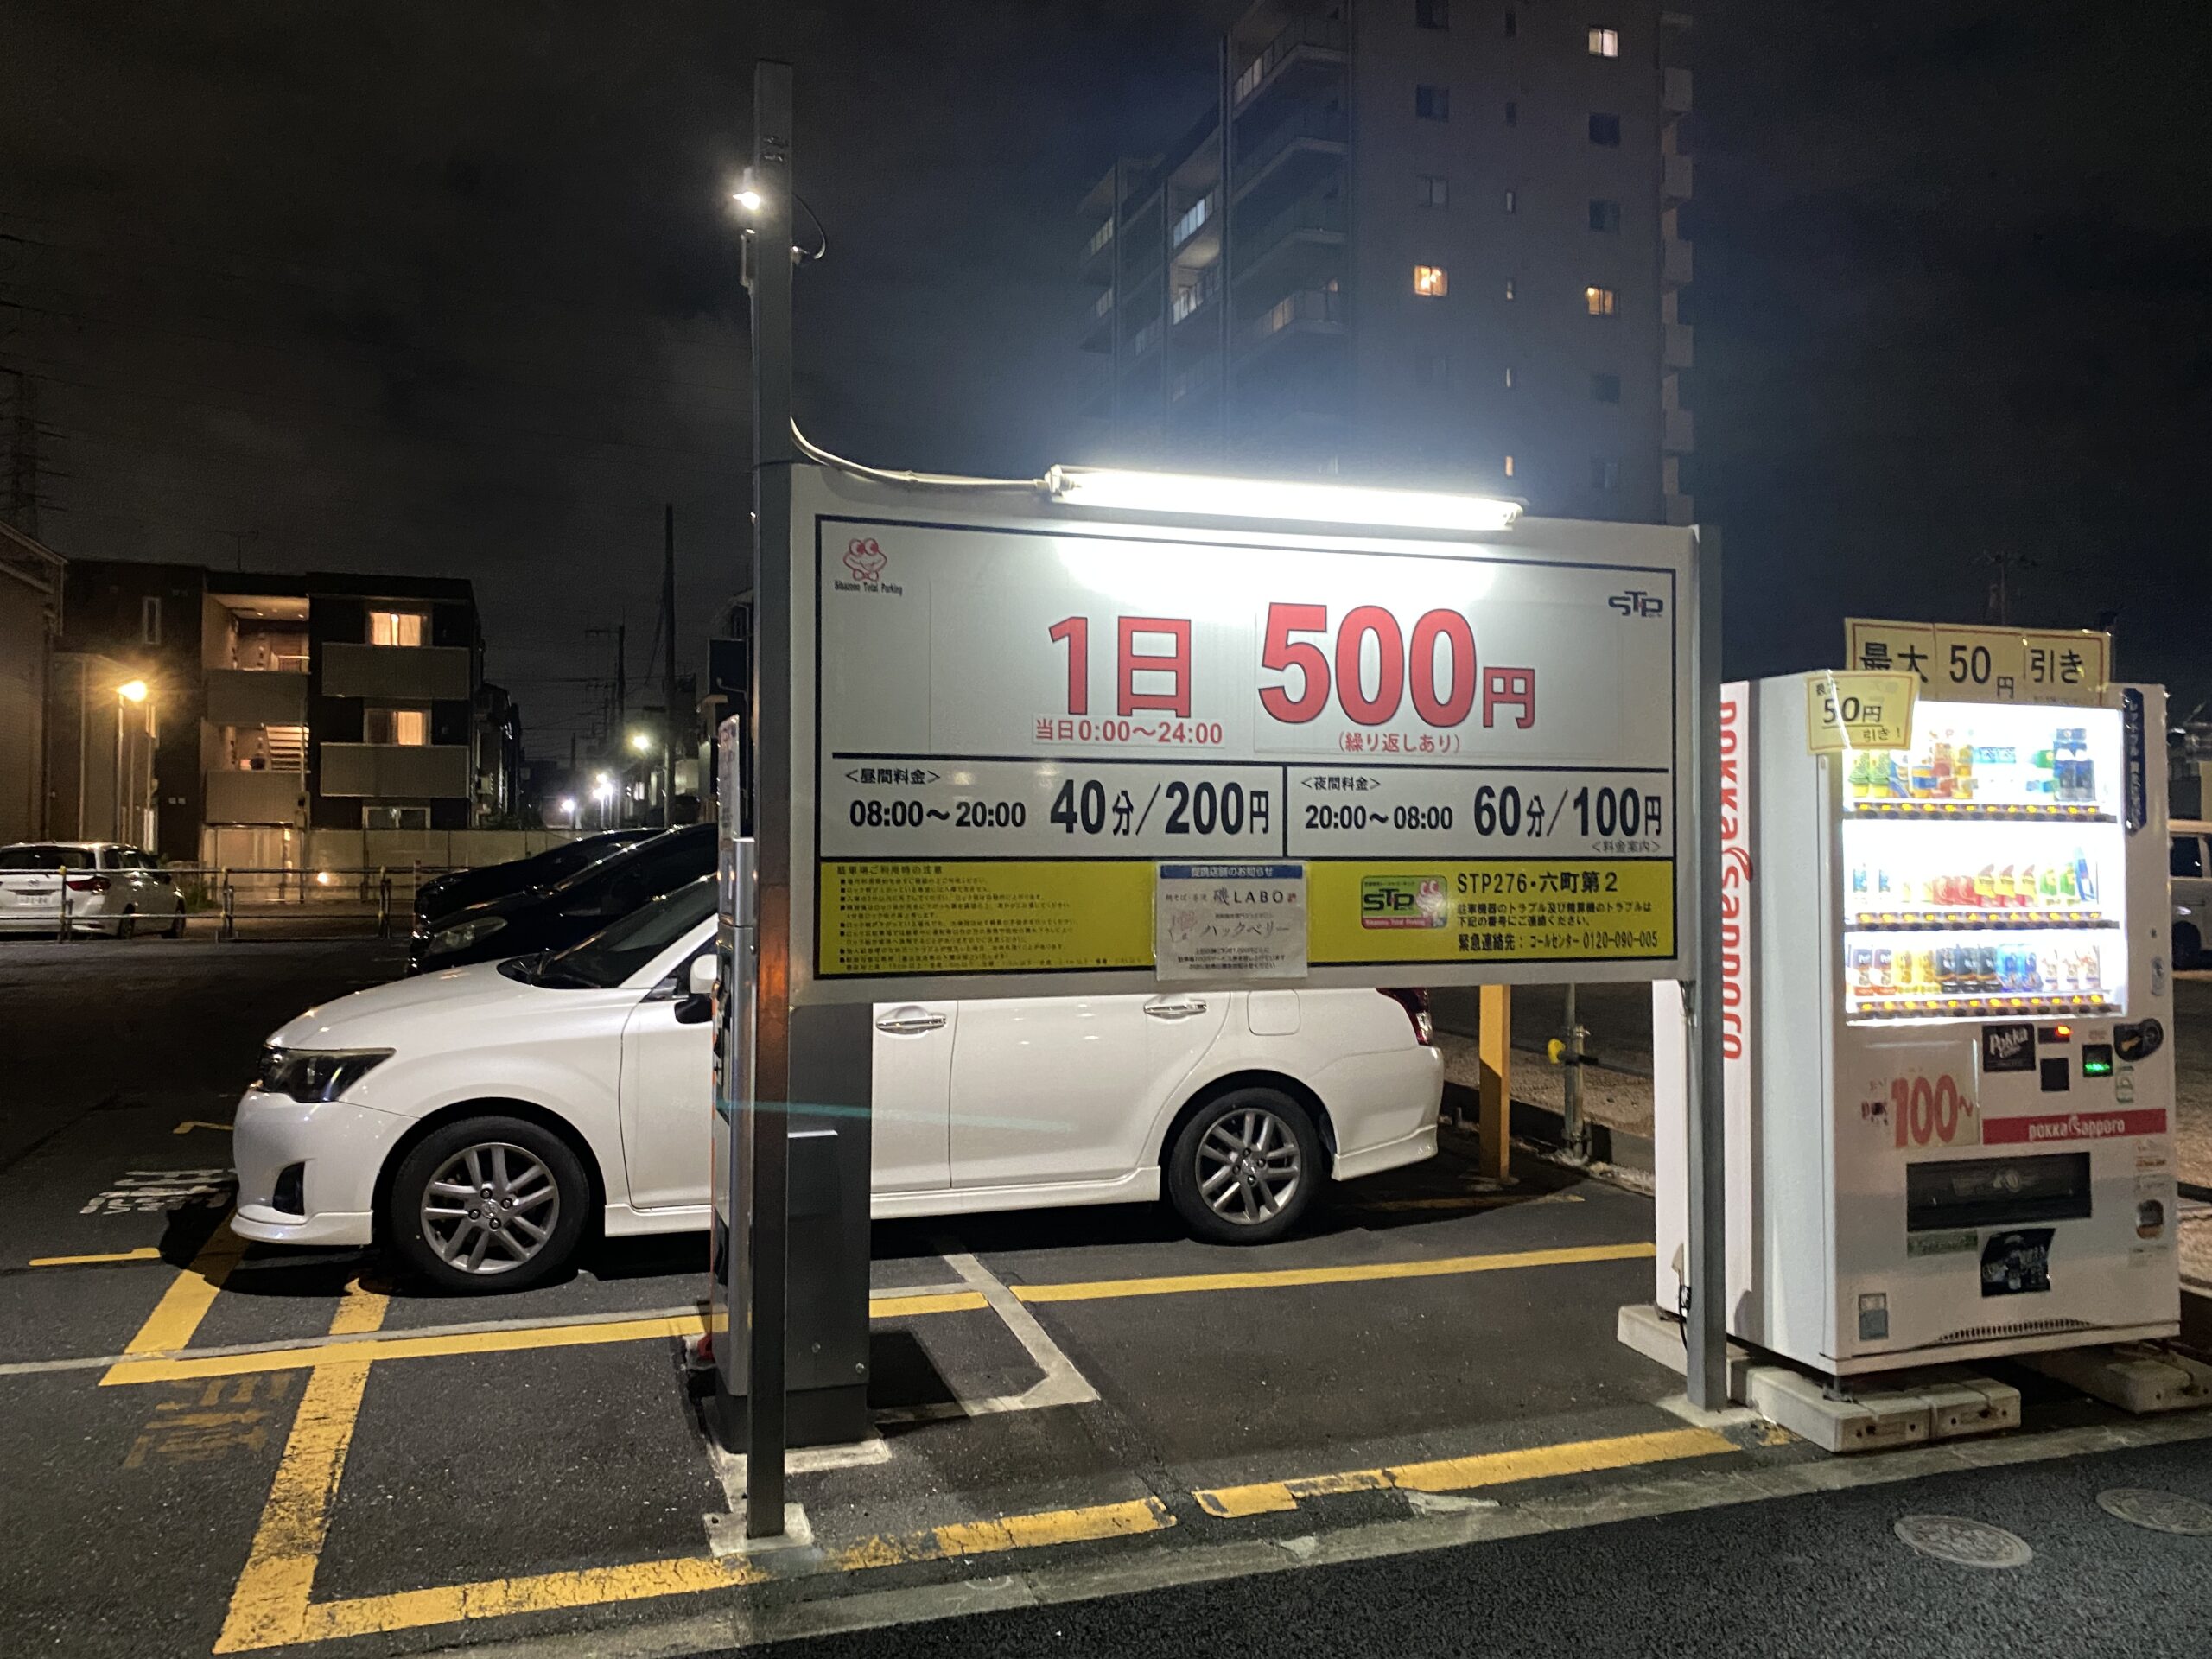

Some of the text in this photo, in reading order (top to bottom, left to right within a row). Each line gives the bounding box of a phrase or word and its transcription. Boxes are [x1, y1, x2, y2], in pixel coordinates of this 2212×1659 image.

[1608, 590, 1663, 617] STP
[1047, 601, 1535, 728] 1日 500円
[1823, 696, 1882, 724] 50円
[1363, 887, 1415, 911] STP
